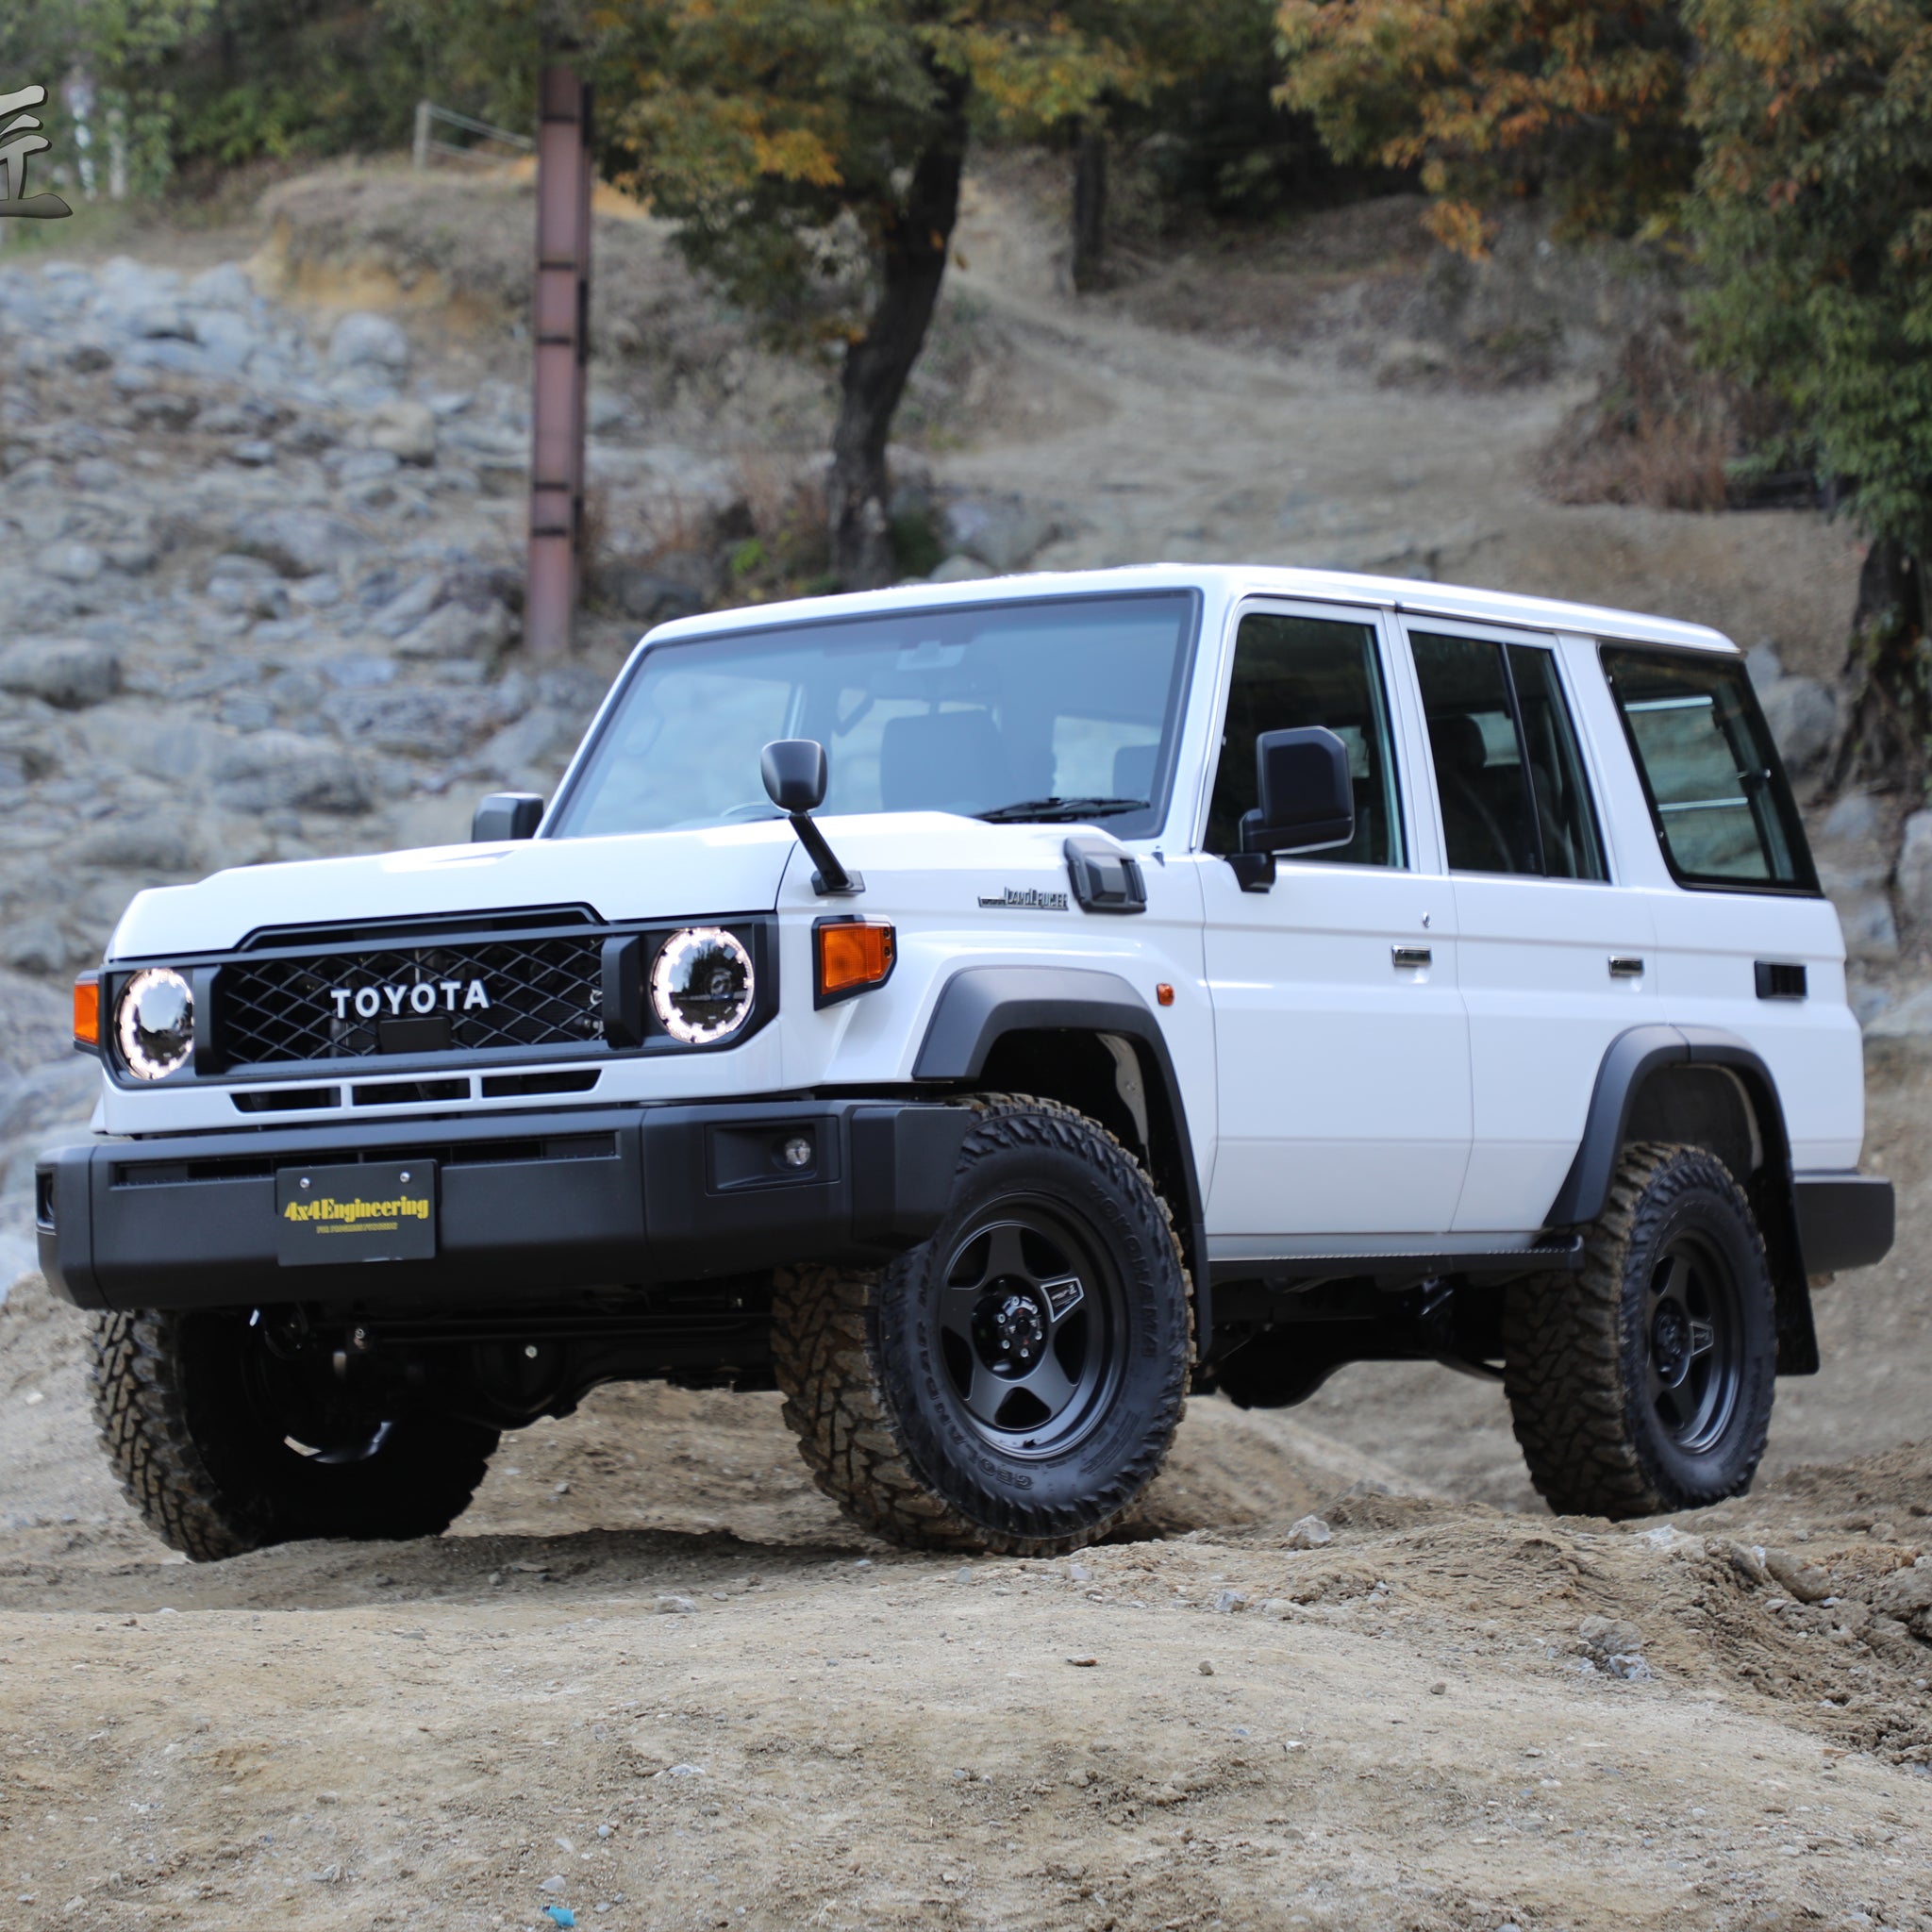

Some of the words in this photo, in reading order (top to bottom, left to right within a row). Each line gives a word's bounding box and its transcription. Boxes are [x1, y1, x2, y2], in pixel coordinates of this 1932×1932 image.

[330, 979, 490, 1019] TOYOTA
[284, 1195, 429, 1223] 4x4Engineering
[1089, 1180, 1160, 1358] YOKOHAMA
[916, 1321, 1034, 1491] GEOLANDAR
